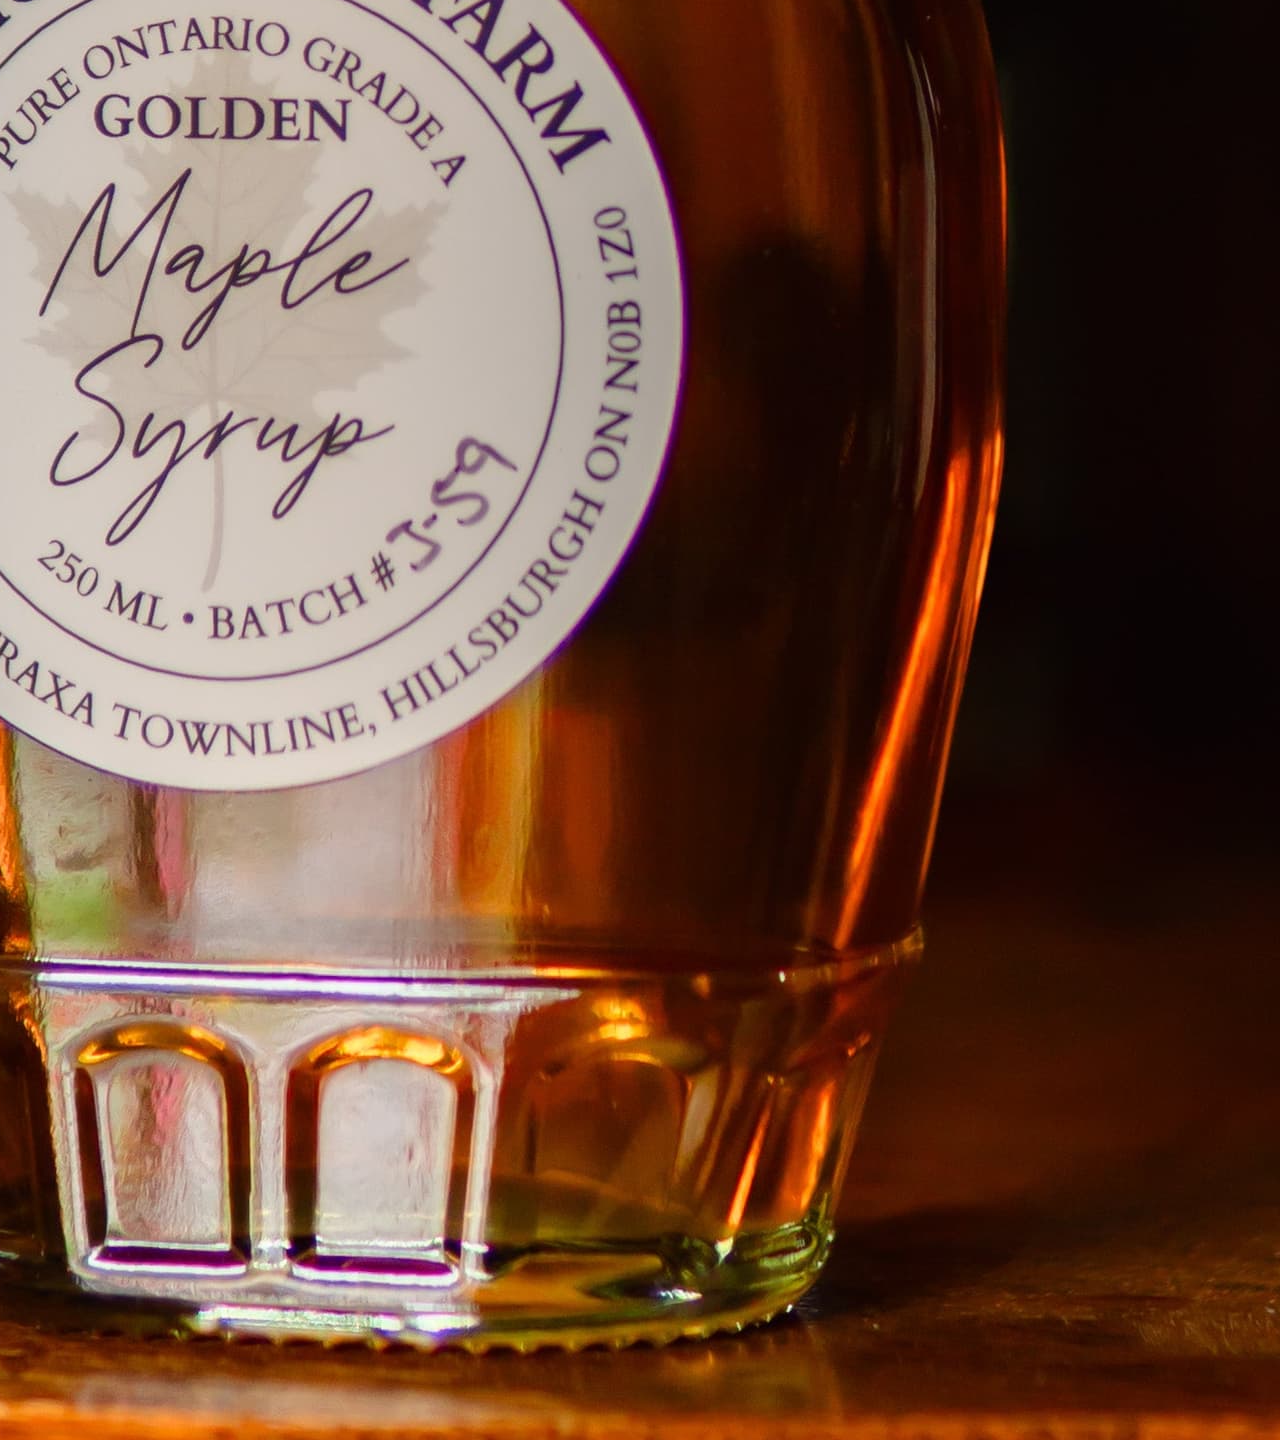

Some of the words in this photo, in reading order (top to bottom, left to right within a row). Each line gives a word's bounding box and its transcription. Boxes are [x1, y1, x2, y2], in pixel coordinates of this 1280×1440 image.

[82, 15, 292, 81] ONTARIO
[302, 36, 445, 152] GRADE
[429, 153, 468, 189] A
[93, 92, 353, 143] GOLDEN
[37, 166, 411, 352] Maple
[48, 332, 396, 548] Syrup
[36, 538, 100, 598] 250
[103, 579, 169, 632] ML
[208, 572, 369, 641] BATCH
[112, 701, 379, 757] TOWNLINE,
[379, 488, 606, 722] HILLSBURGH
[583, 403, 633, 484] ON
